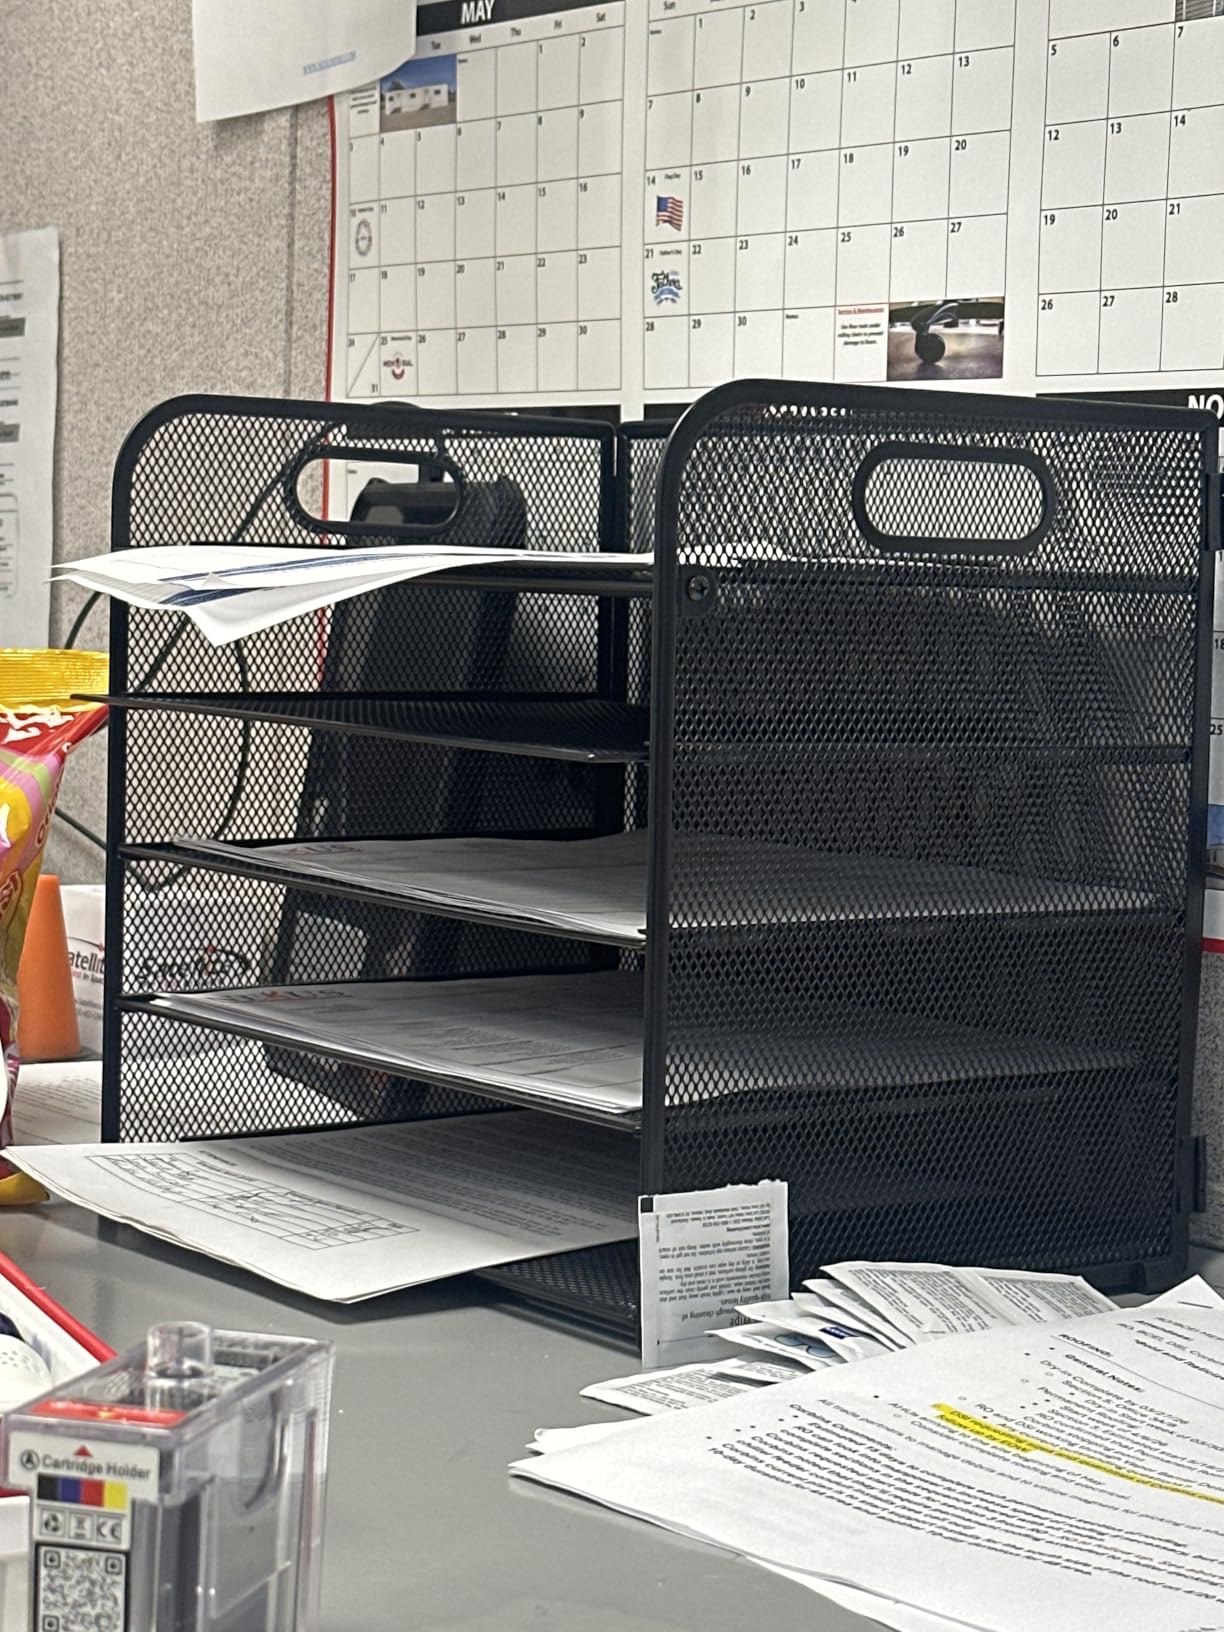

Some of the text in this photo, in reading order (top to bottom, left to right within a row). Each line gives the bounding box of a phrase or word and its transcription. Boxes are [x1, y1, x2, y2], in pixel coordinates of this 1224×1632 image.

[664, 1, 676, 10] Sun
[800, 1, 804, 12] 3
[461, 0, 494, 24] MAY
[750, 10, 755, 20] 2
[596, 13, 606, 22] Sat
[554, 20, 562, 30] Fri
[699, 18, 702, 28] 1
[510, 28, 522, 36] Thu
[1178, 26, 1184, 38] 7
[470, 34, 482, 44] Wed
[581, 37, 586, 47] 2
[1113, 35, 1119, 47] 6
[539, 44, 543, 54] 1
[1051, 44, 1057, 56] 5
[959, 56, 970, 67] 13
[902, 64, 912, 75] 12
[847, 71, 857, 82] 11
[795, 78, 805, 89] 10
[745, 86, 751, 96] 9
[696, 93, 701, 103] 8
[648, 100, 653, 110] 7
[497, 121, 501, 130] 7
[1174, 115, 1186, 127] 14
[1110, 122, 1122, 134] 13
[417, 132, 421, 141] 5
[1048, 130, 1059, 141] 12
[955, 139, 966, 150] 20
[898, 146, 909, 156] 19
[844, 153, 854, 164] 18
[791, 159, 801, 169] 17
[741, 165, 751, 176] 16
[647, 176, 656, 185] 14
[694, 171, 703, 181] 15
[538, 187, 546, 197] 15
[580, 182, 588, 192] 16
[458, 196, 465, 205] 13
[497, 192, 505, 201] 14
[381, 205, 387, 214] 11
[418, 200, 424, 209] 12
[1169, 203, 1180, 215] 21
[1044, 214, 1055, 225] 19
[1106, 209, 1118, 220] 20
[894, 226, 904, 238] 26
[950, 222, 962, 233] 27
[788, 236, 798, 246] 24
[840, 232, 851, 243] 25
[692, 244, 701, 254] 22
[739, 240, 748, 250] 23
[646, 249, 654, 258] 21
[537, 258, 546, 267] 22
[579, 254, 587, 264] 23
[456, 264, 464, 274] 20
[497, 261, 504, 271] 21
[381, 270, 388, 279] 18
[418, 268, 425, 276] 19
[1103, 296, 1115, 306] 27
[1166, 292, 1178, 303] 28
[1041, 299, 1053, 310] 26
[692, 319, 701, 329] 29
[737, 316, 747, 326] 30
[579, 325, 587, 335] 30
[646, 322, 654, 332] 28
[458, 332, 465, 342] 27
[497, 329, 506, 339] 28
[537, 328, 546, 337] 29
[418, 334, 426, 344] 26
[1210, 724, 1223, 736] 25
[1059, 1334, 1112, 1357] ROOFING:
[1065, 1355, 1142, 1392] General Notes:
[1040, 1360, 1072, 1376] Dry-in
[1073, 1376, 1124, 1400] Complete
[1038, 1387, 1096, 1413] Permanent
[1062, 1380, 1148, 1417] Section Office
[833, 1405, 860, 1417] trade
[1060, 1406, 1116, 1428] Start week
[1084, 1400, 1174, 1435] Dry-in Start week
[789, 1404, 893, 1450] Corbins Comments:
[976, 1404, 1079, 1447] RO and DSI working
[1048, 1409, 1089, 1426] Section
[1102, 1430, 1160, 1451] Estimated
[808, 1423, 866, 1446] Estimated
[752, 1436, 794, 1455] Corbins
[766, 1433, 809, 1452] Corbins
[42, 1454, 151, 1480] Cartridge Holder
